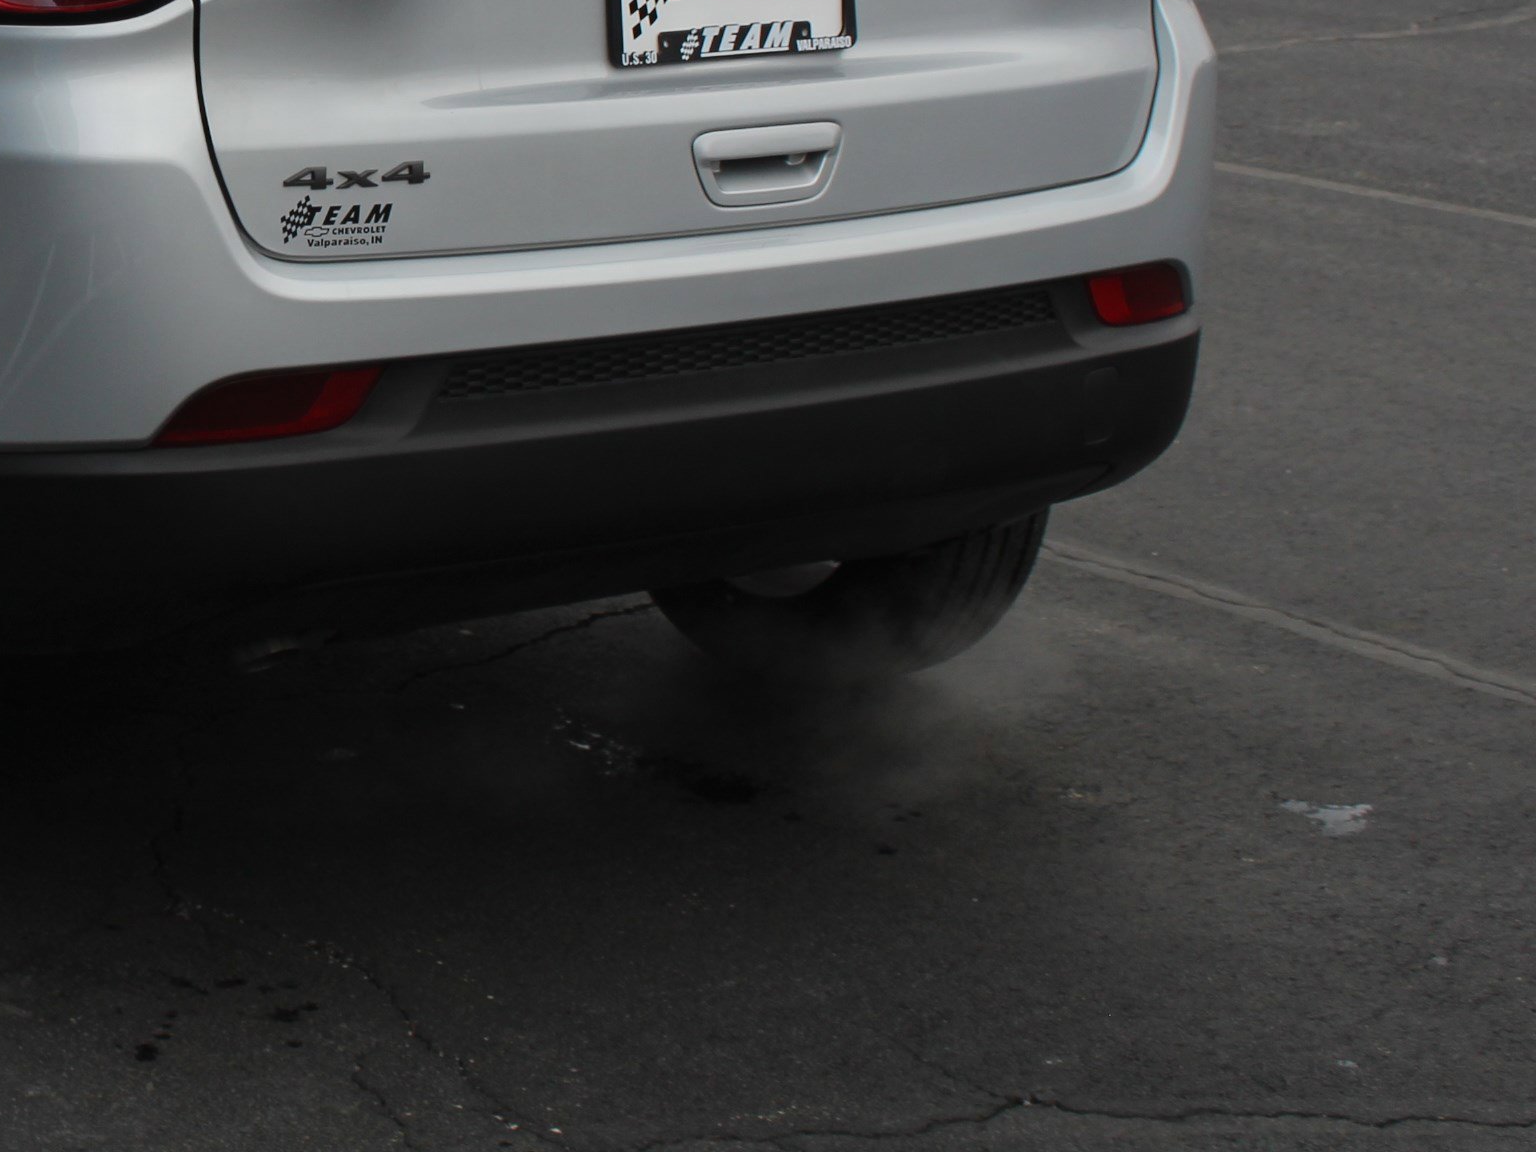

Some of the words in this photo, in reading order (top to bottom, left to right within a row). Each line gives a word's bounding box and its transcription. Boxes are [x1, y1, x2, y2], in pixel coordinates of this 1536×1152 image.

[700, 20, 794, 54] TEAM
[796, 35, 852, 52] VALPARAISO
[621, 53, 643, 66] U.S.
[645, 51, 658, 65] 30
[283, 160, 431, 190] 4x4
[306, 203, 393, 225] TEAM
[332, 226, 386, 235] CHEVROLET
[307, 236, 369, 248] Valparaiso,
[371, 235, 383, 244] IN
